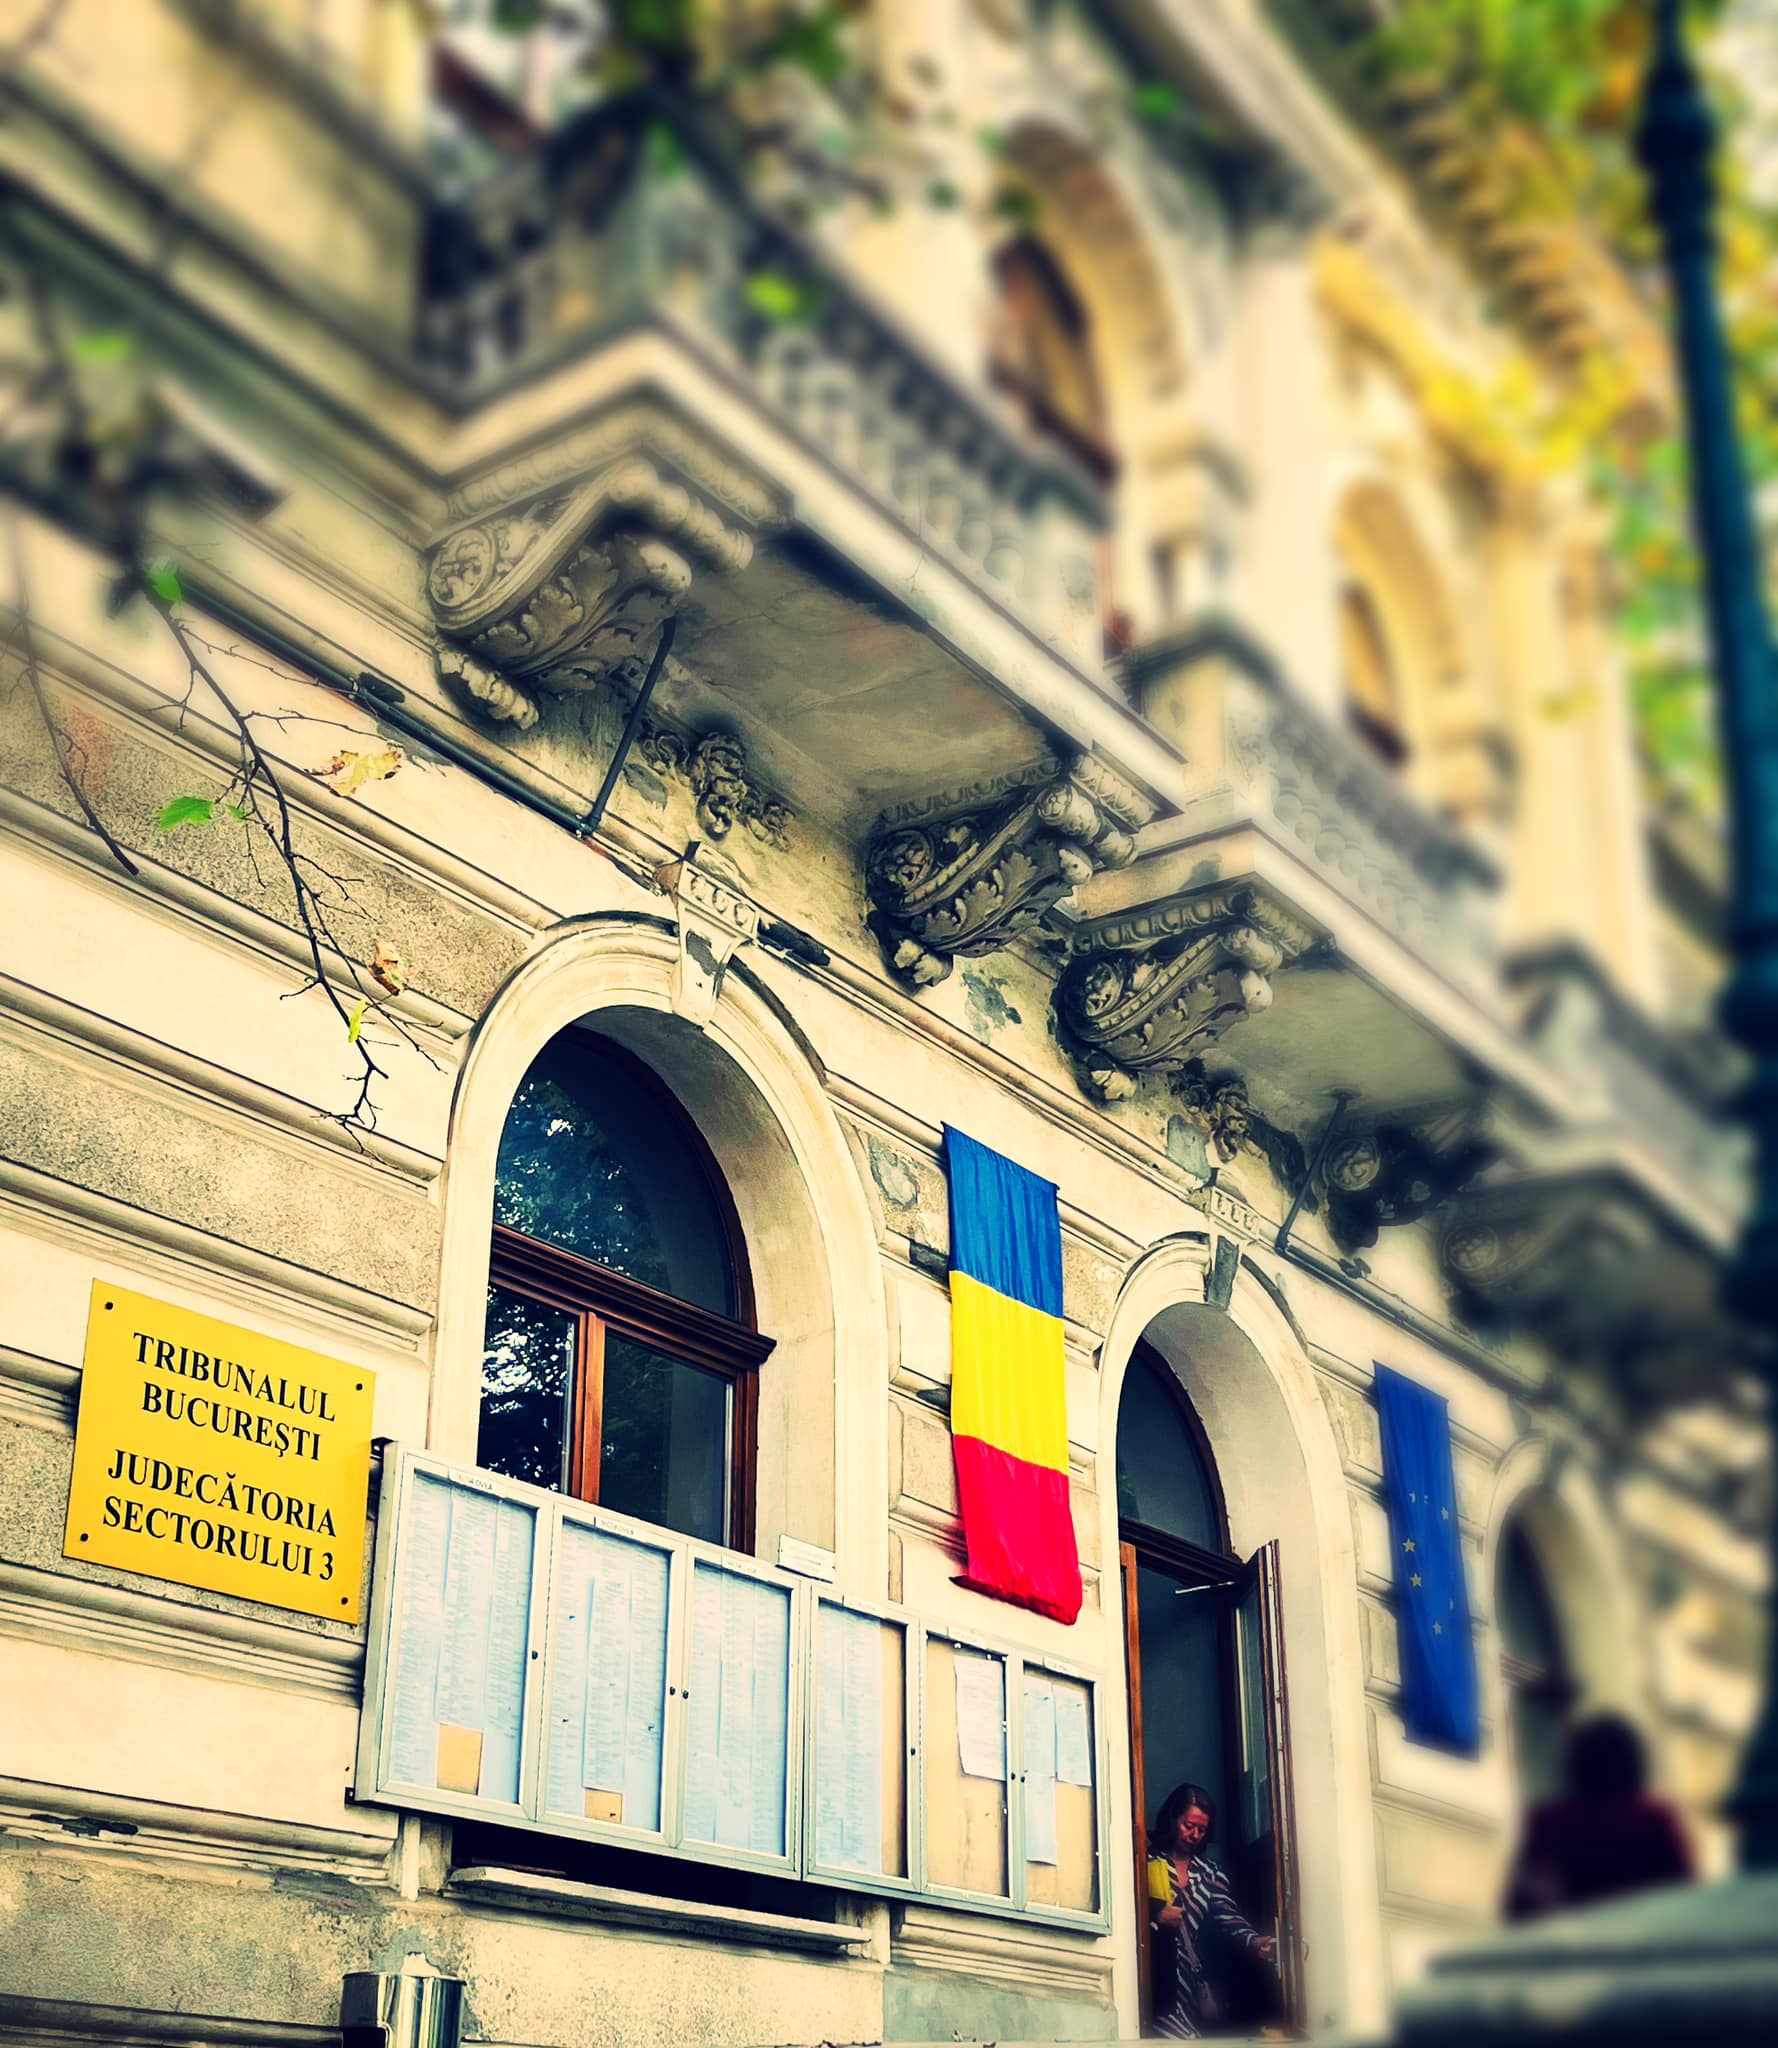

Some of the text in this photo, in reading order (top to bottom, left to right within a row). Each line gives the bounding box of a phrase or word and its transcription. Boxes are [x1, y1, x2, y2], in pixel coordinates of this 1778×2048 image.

[133, 1332, 336, 1422] TRIBUNALUL
[108, 1449, 337, 1537] JUDECĂTORIA
[103, 1496, 334, 1581] SECTORULUI 3
